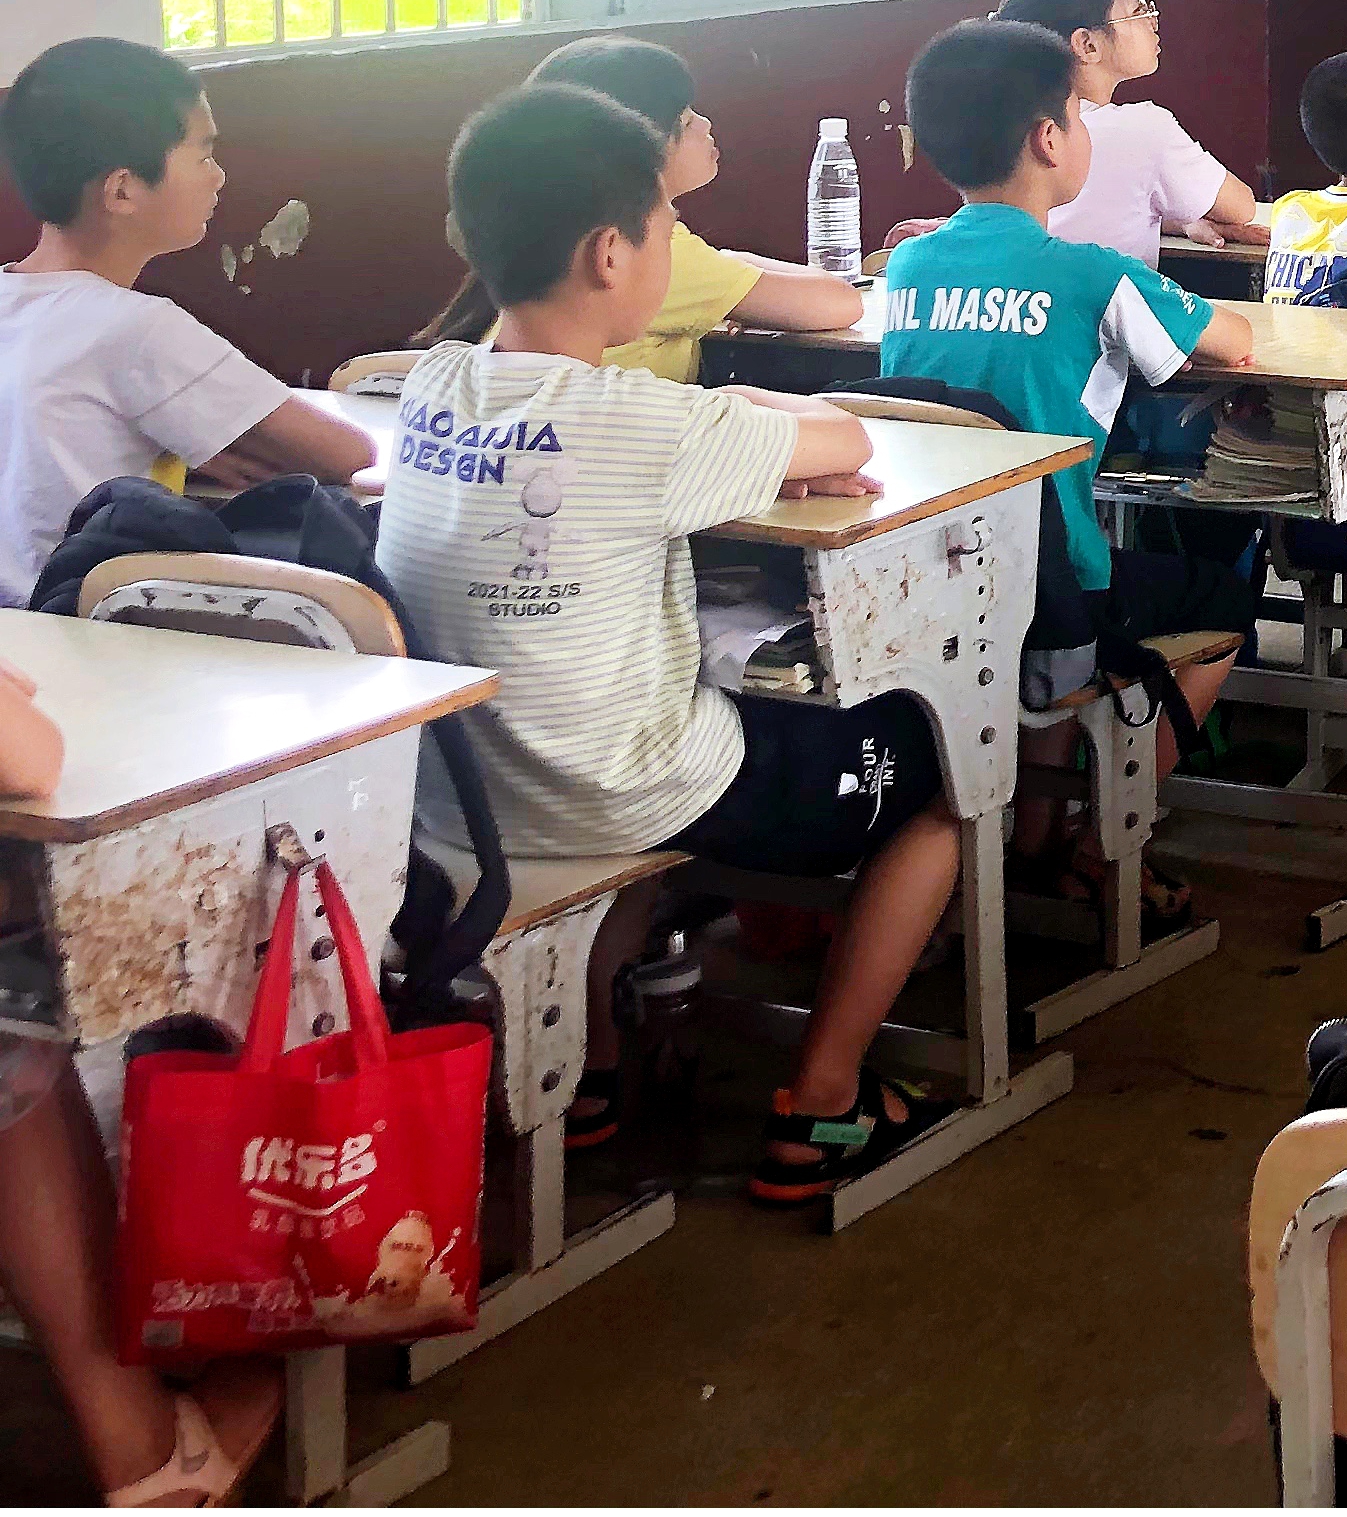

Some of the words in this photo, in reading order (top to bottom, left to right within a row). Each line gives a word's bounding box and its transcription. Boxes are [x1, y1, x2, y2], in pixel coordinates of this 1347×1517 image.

[1264, 251, 1328, 294] CHIC
[929, 286, 1052, 336] MASKS
[467, 581, 542, 600] 2021-22
[546, 583, 582, 599] S/S
[488, 601, 562, 618] STUDIO
